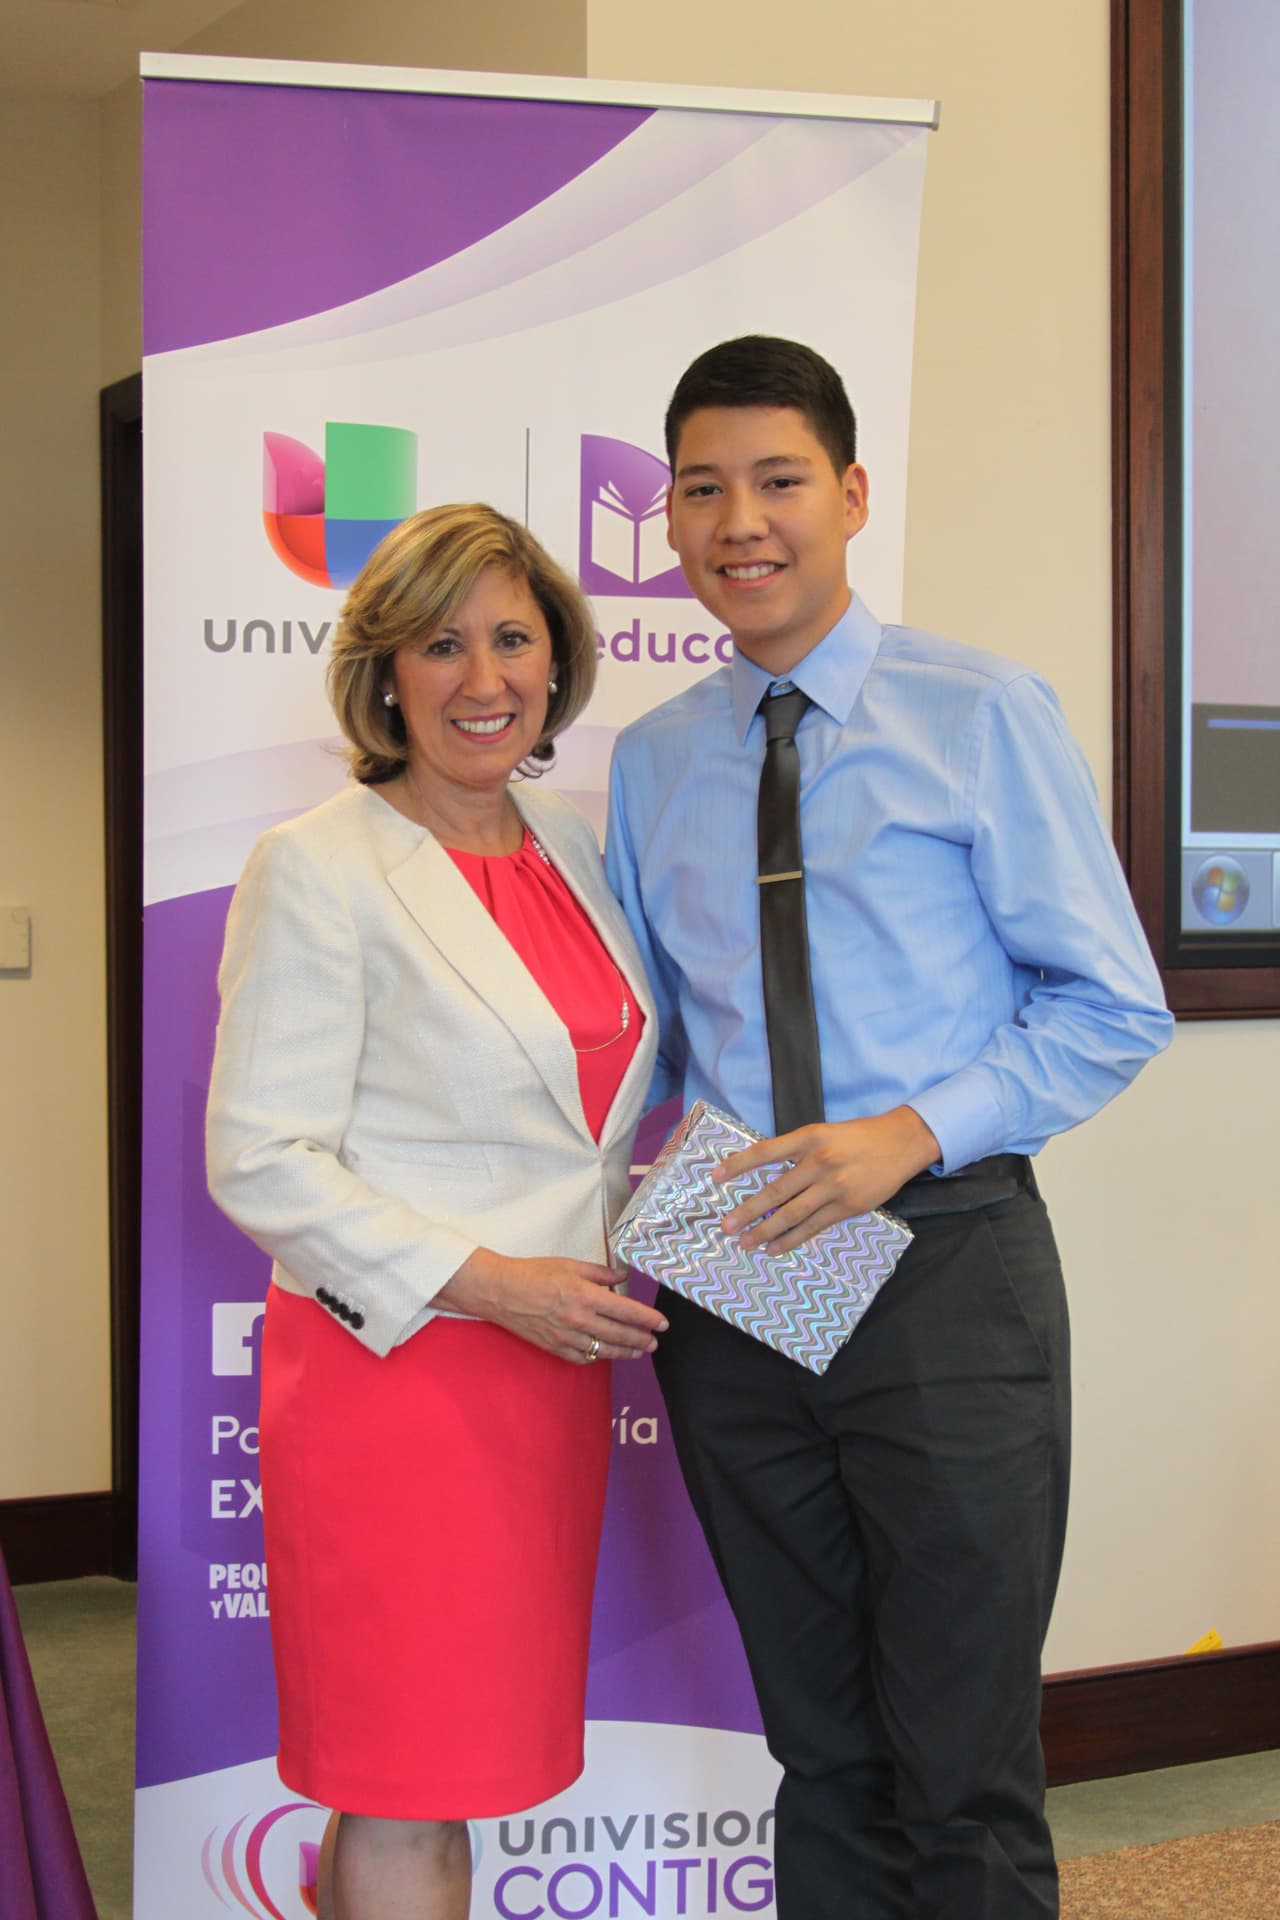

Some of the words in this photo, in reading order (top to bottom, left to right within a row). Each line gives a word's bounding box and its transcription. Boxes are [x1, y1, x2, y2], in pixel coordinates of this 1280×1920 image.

[612, 1406, 658, 1445] ía
[211, 1479, 263, 1519] EX
[493, 1855, 774, 1920] CONTIG
